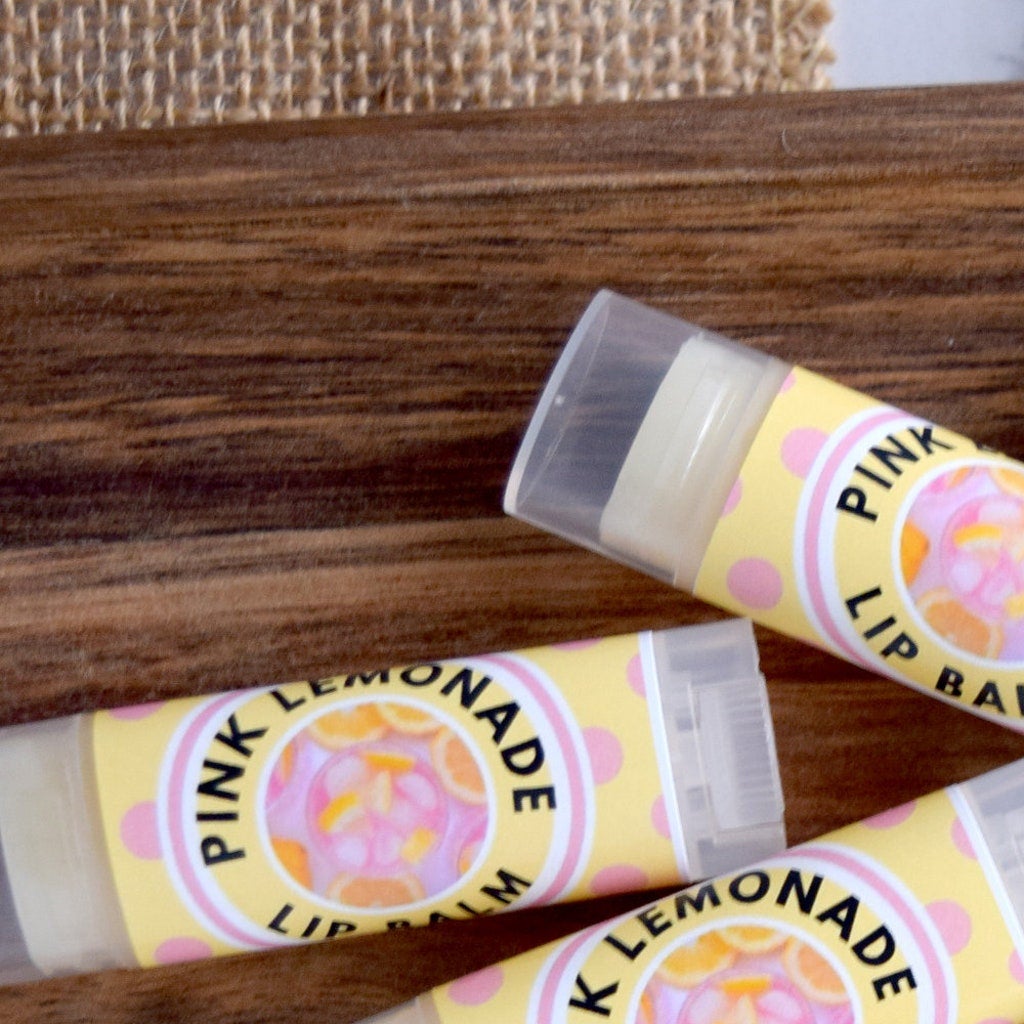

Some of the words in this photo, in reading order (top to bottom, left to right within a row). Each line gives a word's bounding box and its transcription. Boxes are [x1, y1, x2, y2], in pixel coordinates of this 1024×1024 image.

[836, 425, 955, 524] PINK
[845, 586, 919, 660] LIP
[196, 713, 269, 867] PINK
[267, 902, 357, 938] LIP
[603, 867, 918, 1003] LEMONADE
